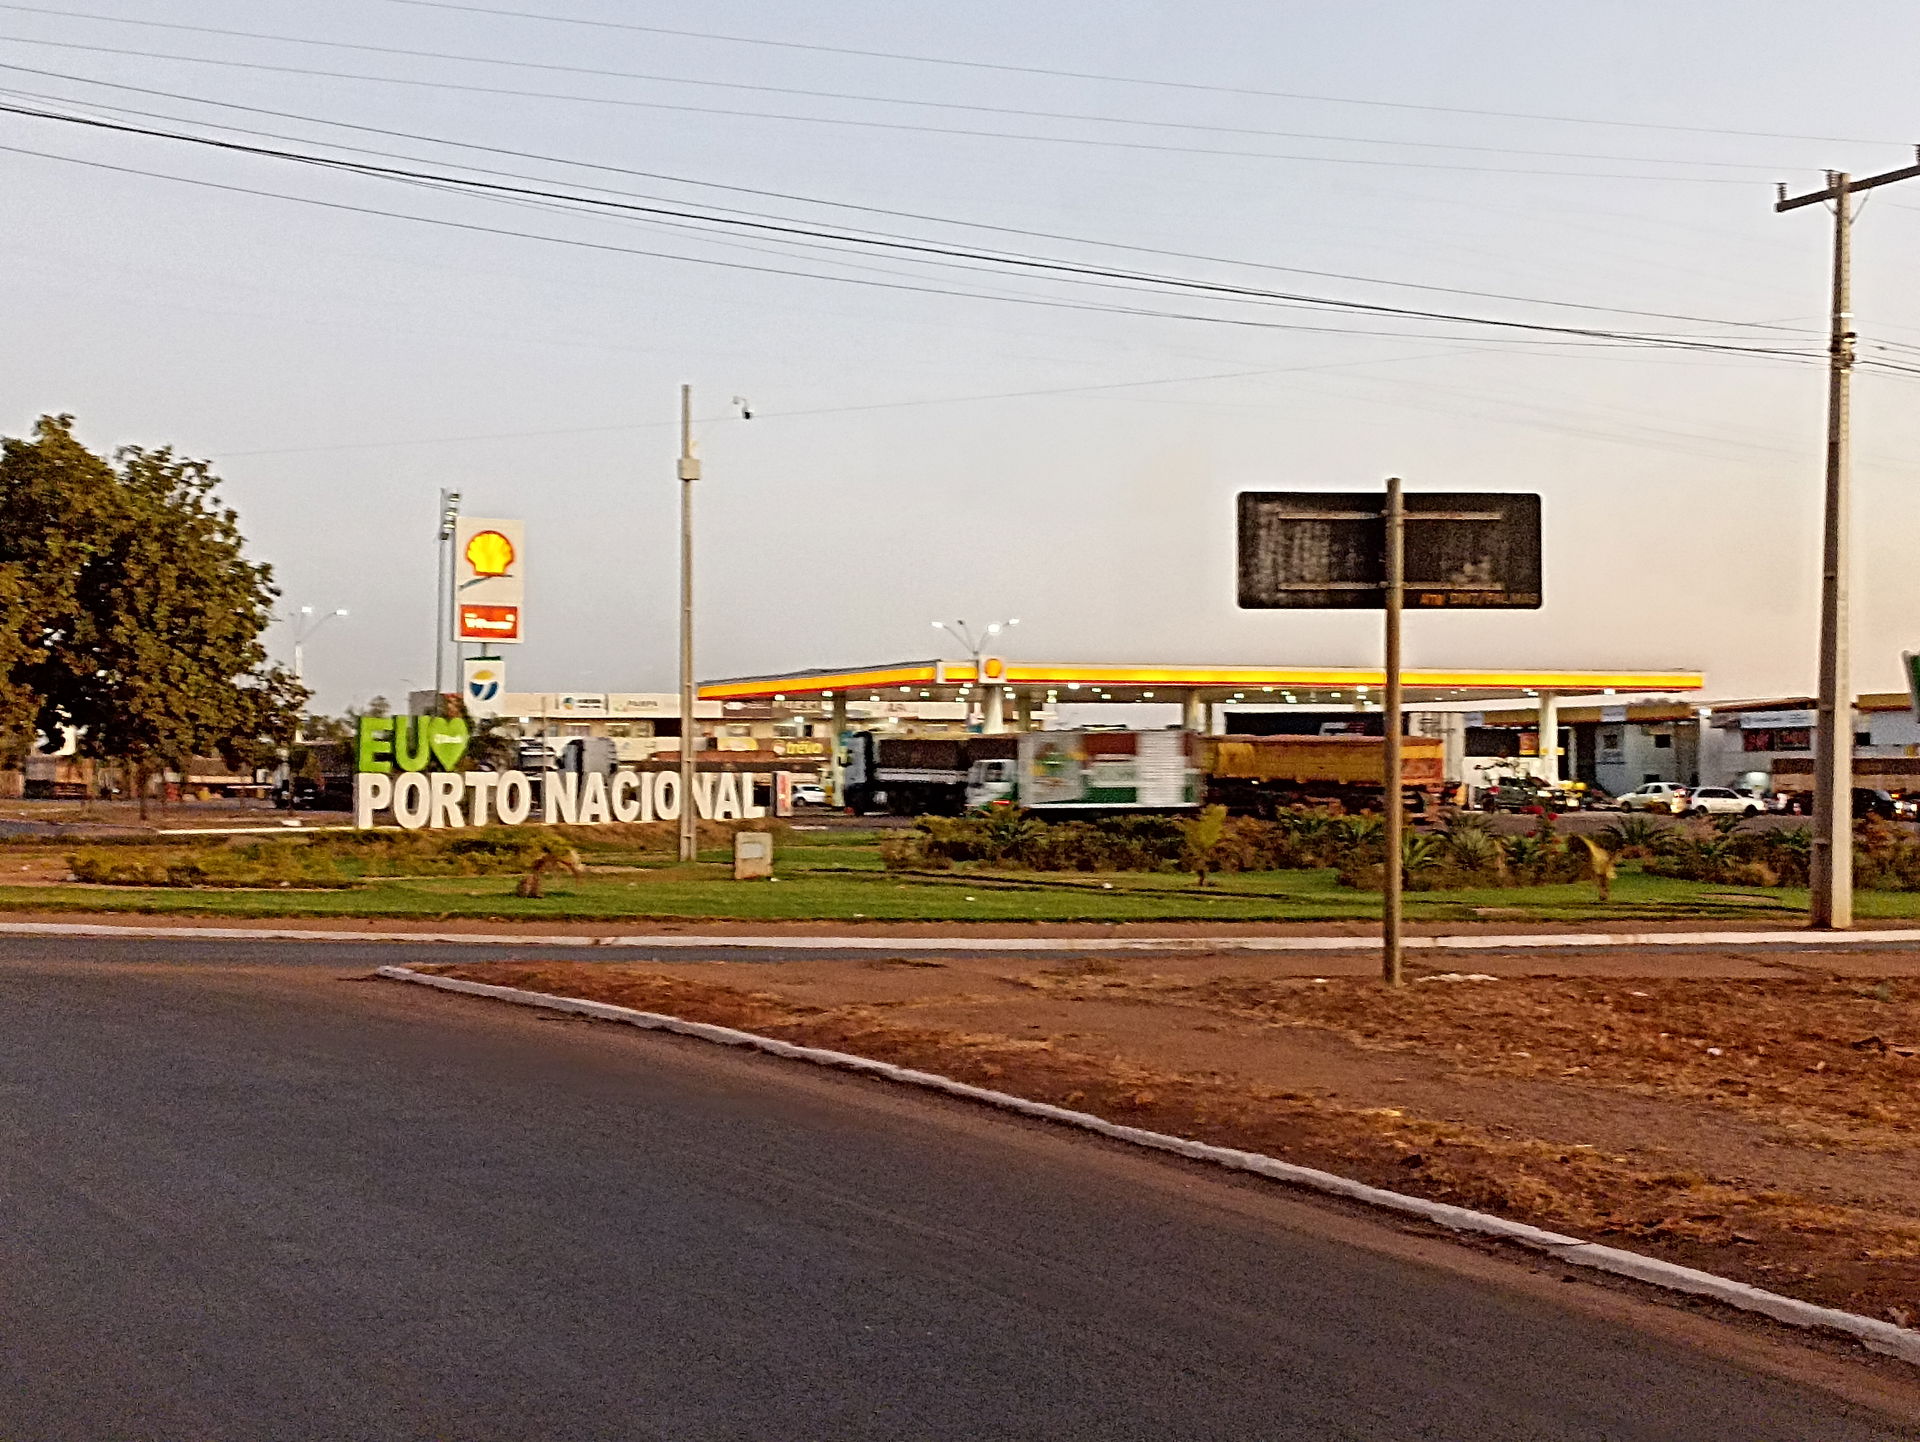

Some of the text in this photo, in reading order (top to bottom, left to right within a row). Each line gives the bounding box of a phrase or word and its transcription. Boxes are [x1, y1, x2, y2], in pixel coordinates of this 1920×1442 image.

[358, 716, 431, 773] EU
[357, 770, 531, 829] PORTO
[544, 770, 766, 825] NACIONAL
